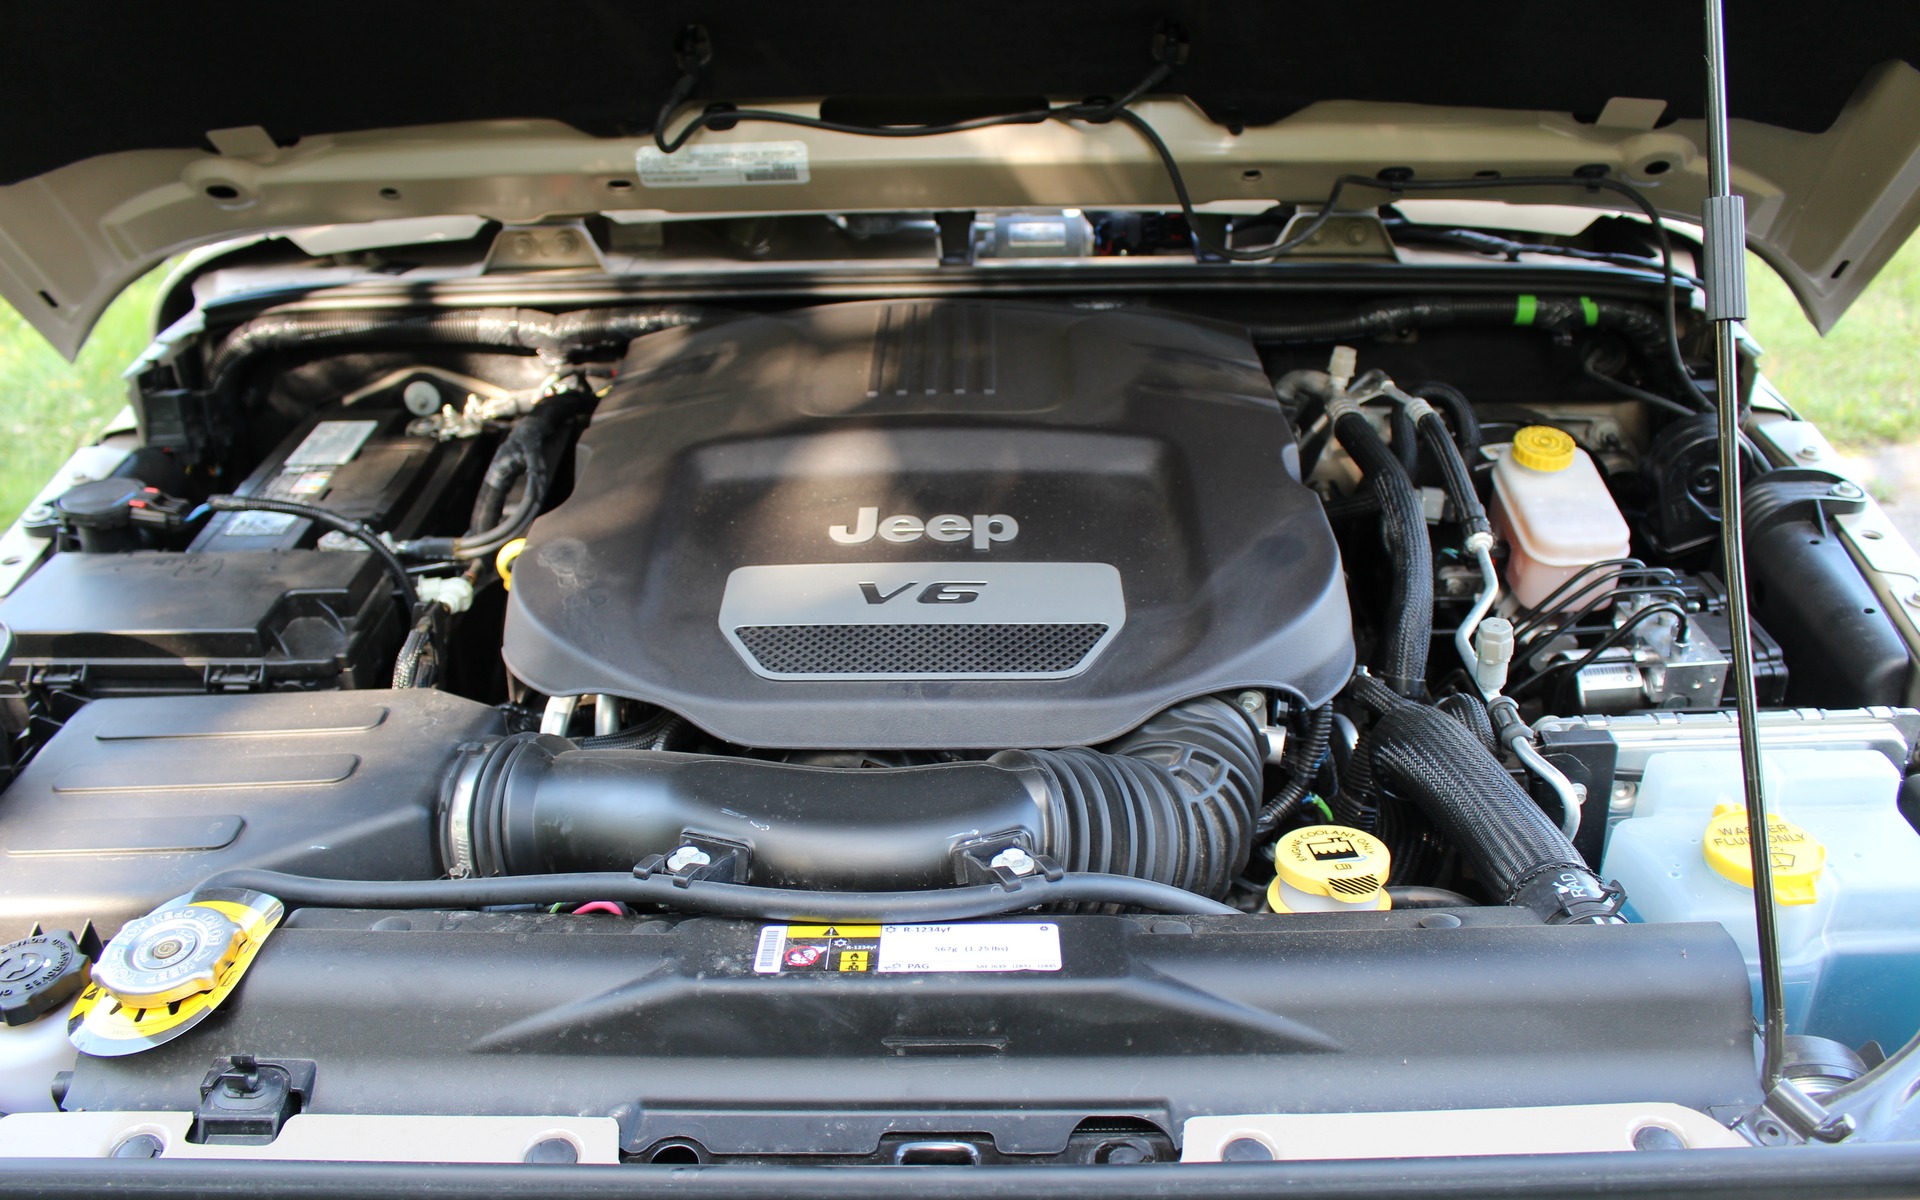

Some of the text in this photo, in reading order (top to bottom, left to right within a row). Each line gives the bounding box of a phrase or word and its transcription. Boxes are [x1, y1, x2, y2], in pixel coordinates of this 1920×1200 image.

[829, 507, 1019, 551] Jeep
[859, 581, 988, 604] V6
[1291, 829, 1375, 863] ENGINE COOLANT ONLY
[1714, 836, 1751, 846] FLUI
[1560, 873, 1588, 898] RAD
[151, 908, 196, 925] OPEN
[117, 919, 149, 945] HOT
[144, 963, 196, 984] KEEP
